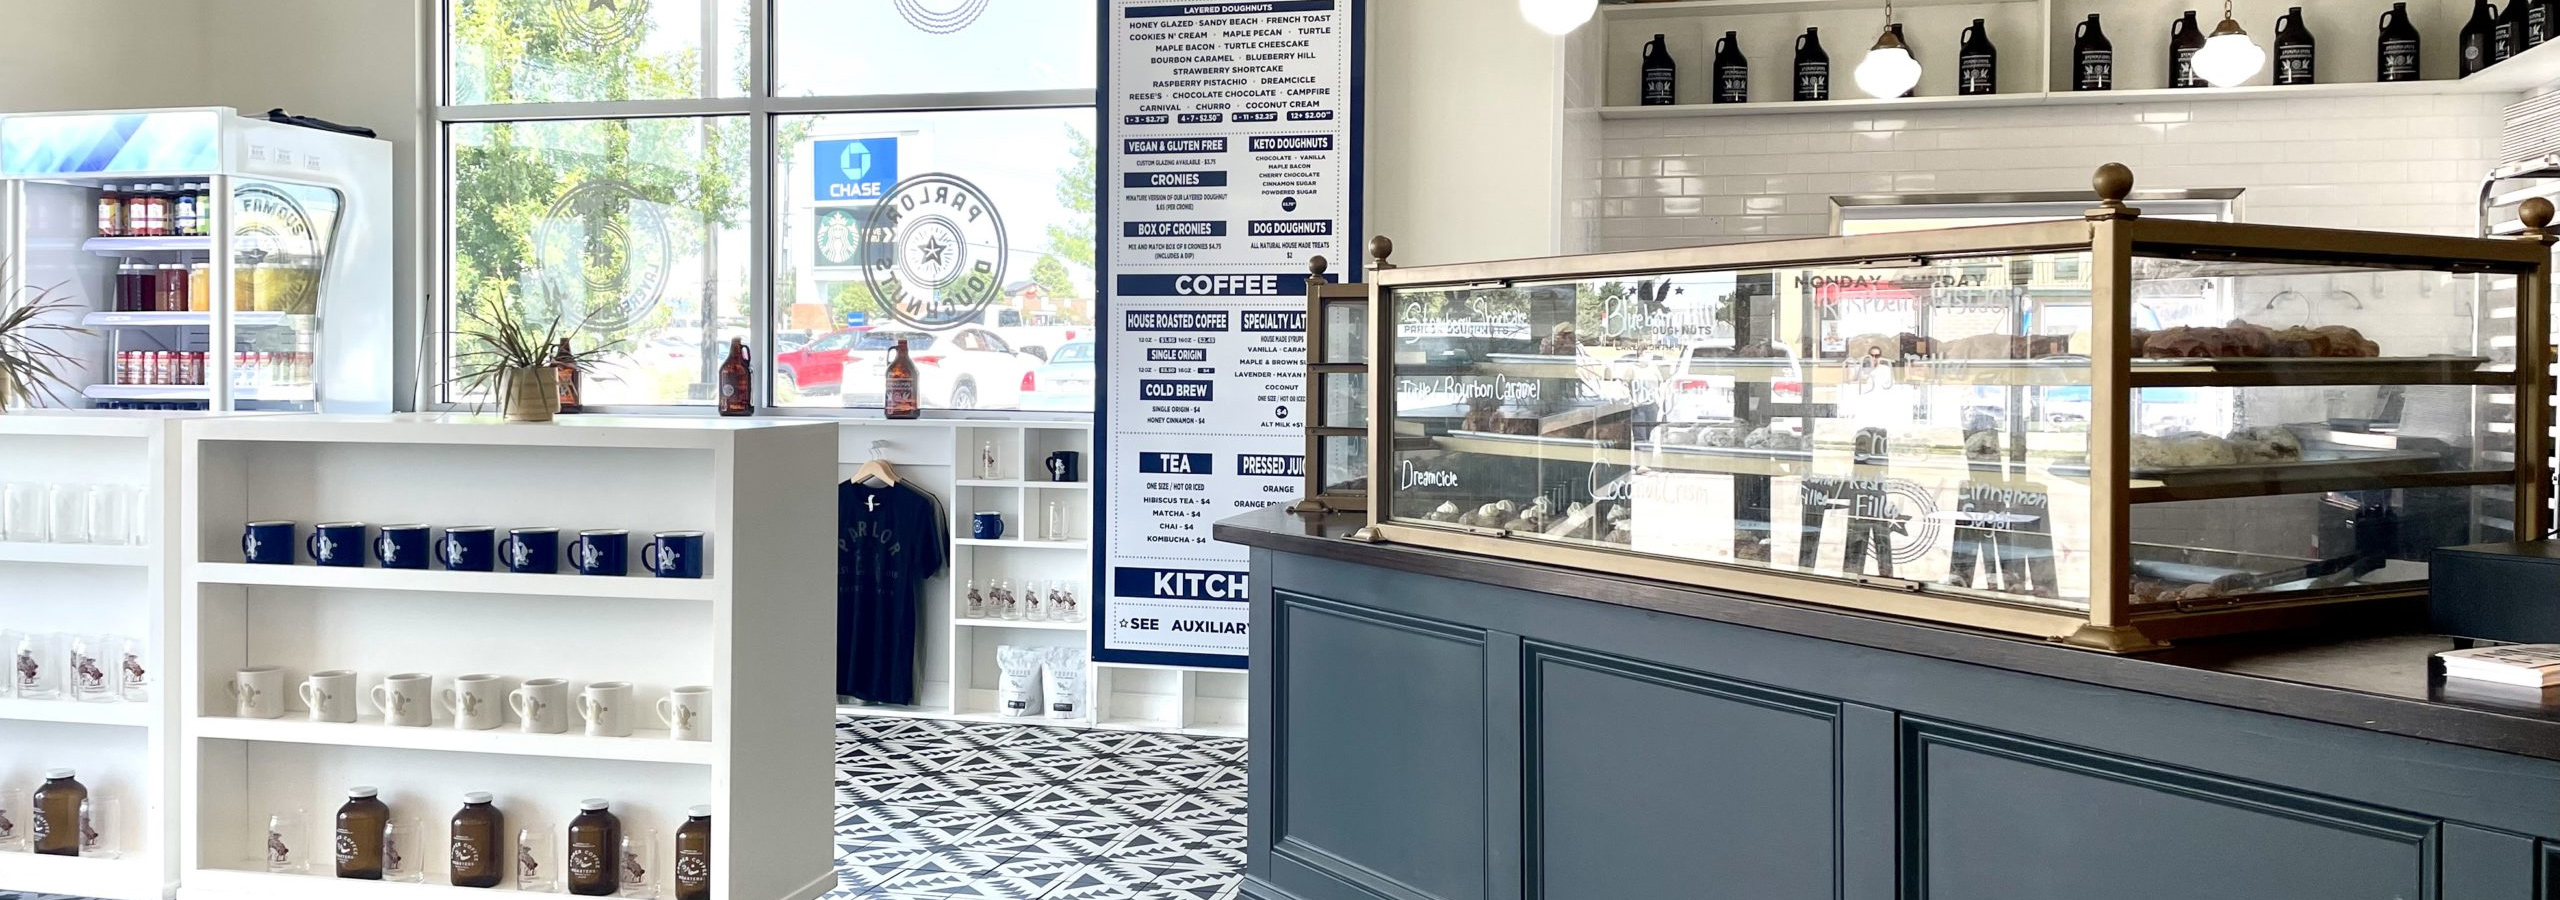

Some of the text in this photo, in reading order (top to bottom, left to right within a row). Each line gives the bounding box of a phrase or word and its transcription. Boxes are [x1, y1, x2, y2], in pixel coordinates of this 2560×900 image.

[1184, 4, 1273, 14] LAYERED DOUGHNUTS
[1160, 20, 1194, 28] GLAZED
[1266, 16, 1300, 24] FRENCH
[1298, 27, 1331, 35] TURTLE
[1258, 40, 1310, 48] CHEESCAKE
[1246, 53, 1295, 61] BLUEBERRY
[1173, 65, 1284, 75] STRAWBERRY SHORTCAKE
[1153, 76, 1316, 87] RASPBERRY PISTACHIO DREAMCICLE
[1172, 91, 1223, 99] CHOCOLATE
[1287, 88, 1331, 96] CAMPFIRE
[1246, 101, 1287, 109] COCONUT
[1289, 100, 1320, 108] CREAM
[1129, 139, 1223, 152] VEGAN & GLUTEN FREE
[1254, 137, 1328, 149] KETO DOUGHNUTS
[1151, 173, 1200, 185] CRONIES
[830, 182, 881, 198] CHASE
[243, 199, 304, 236] FAMOUS
[1138, 223, 1211, 235] BOX OF CRONIES
[1254, 222, 1326, 234] DOG DOUGHNUTS
[1175, 275, 1278, 295] COFFEE
[1795, 275, 1881, 288] MONDAY
[1127, 314, 1227, 328] HOUSE ROASTED COFFEE
[1244, 313, 1289, 329] SPECIALTY
[1151, 350, 1202, 360] SINGLE ORIGIN
[1145, 384, 1207, 397] COLD BREW
[1444, 373, 1541, 401] Bourbon Caramel
[1160, 454, 1191, 473] TEA
[1243, 457, 1285, 474] PRESSED
[1402, 459, 1459, 491] Dreamcicle
[1263, 485, 1294, 493] ORANGE
[1234, 500, 1265, 508] ORANGE
[838, 521, 901, 557] PARLOR
[1196, 536, 1206, 544] $4
[1154, 571, 1249, 599] KITCH
[1130, 617, 1159, 631] SEE
